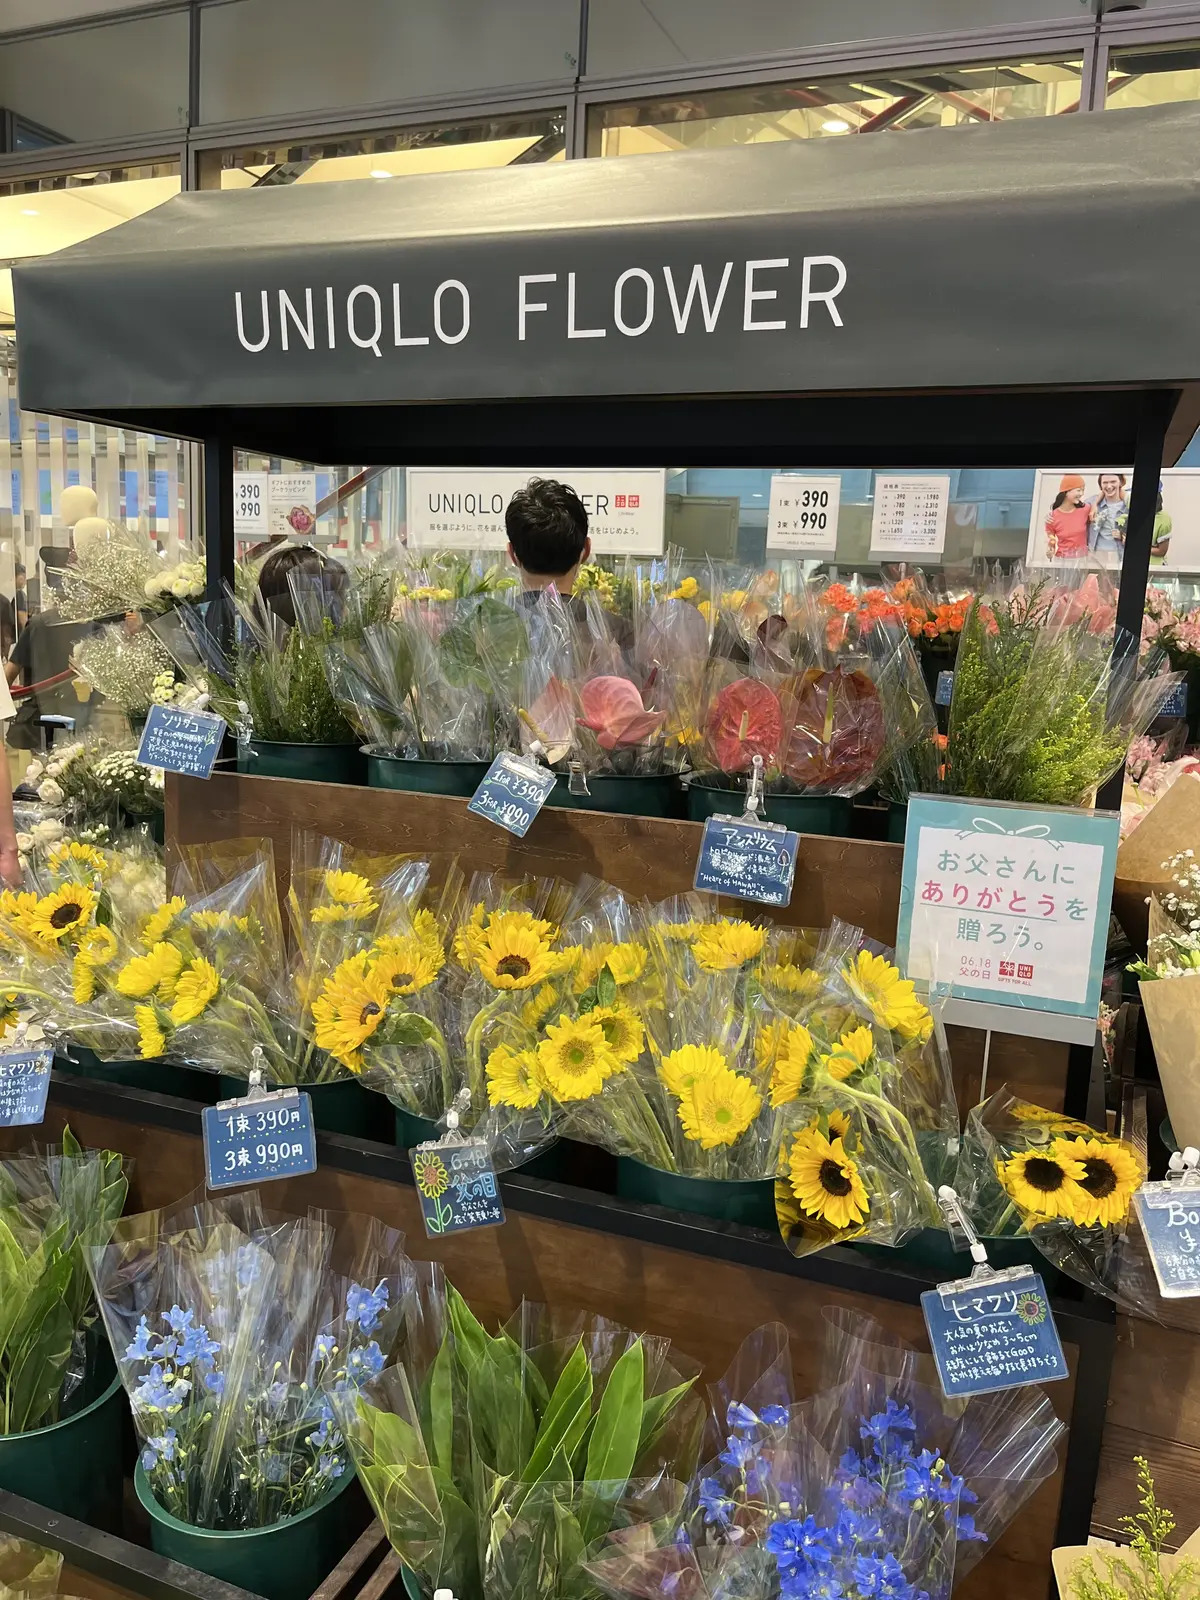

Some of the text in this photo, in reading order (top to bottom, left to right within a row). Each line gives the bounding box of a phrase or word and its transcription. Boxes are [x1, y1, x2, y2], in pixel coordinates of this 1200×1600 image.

[235, 255, 847, 357] UNIQLO FLOWER
[429, 493, 503, 516] UNIQLO
[721, 828, 777, 854] アンスリウム
[937, 849, 1076, 884] お父さんに
[921, 879, 1088, 921] ありがとうを
[956, 917, 1044, 951] 贈ろう。
[959, 966, 991, 980] 父の日
[960, 955, 992, 968] 06.18
[256, 1108, 300, 1131] 390円
[256, 1142, 303, 1164] 990円
[451, 1150, 487, 1170] 6.18
[450, 1172, 497, 1203] 父の日
[952, 1290, 1018, 1321] ヒマワリ
[944, 1320, 1015, 1343] 大人気の夏のお花!
